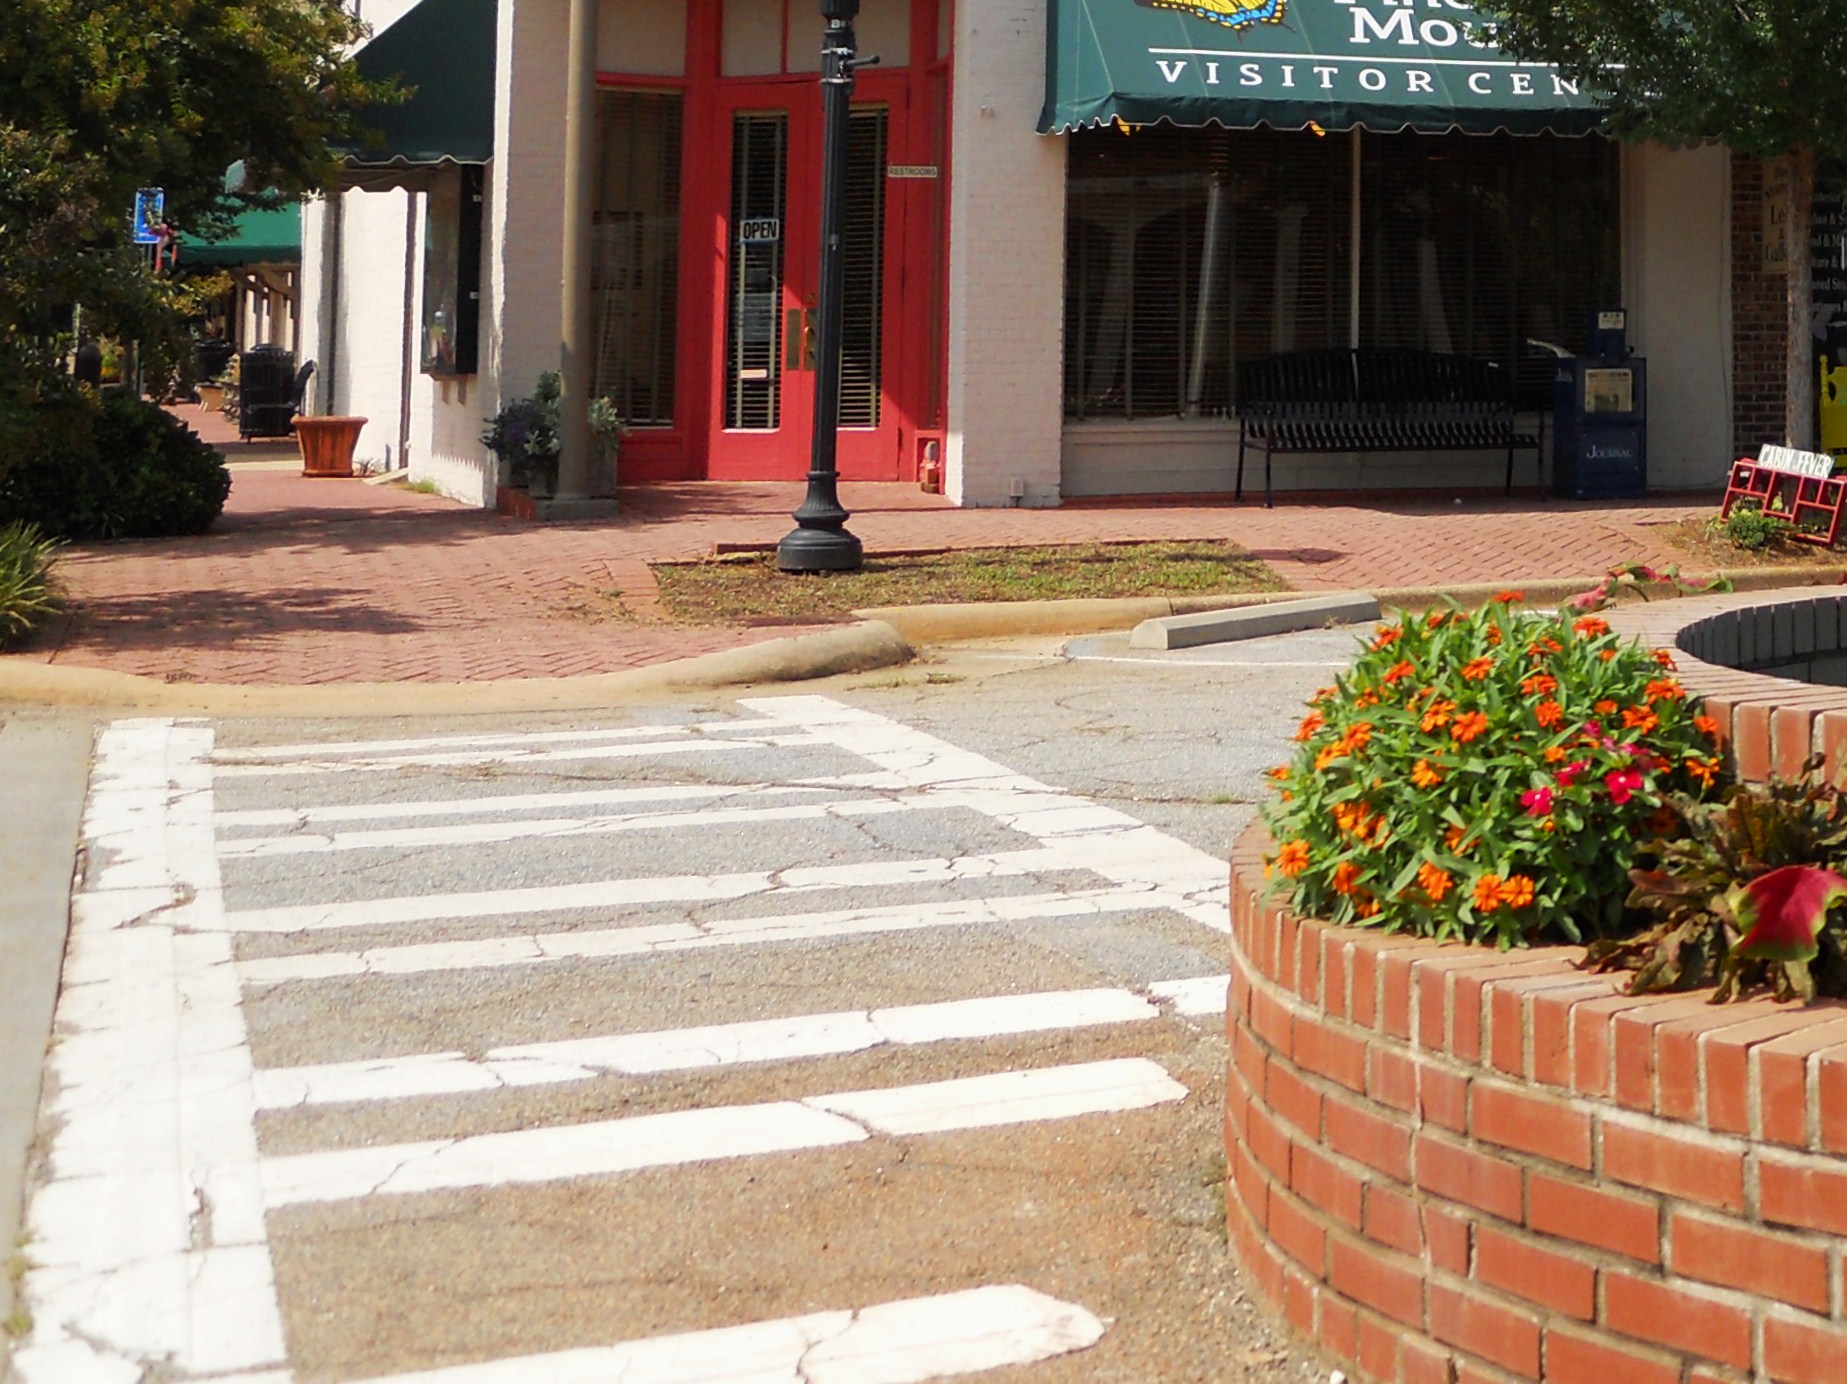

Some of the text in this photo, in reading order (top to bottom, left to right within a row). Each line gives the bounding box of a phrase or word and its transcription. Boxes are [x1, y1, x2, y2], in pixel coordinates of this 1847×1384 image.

[1156, 60, 1582, 95] VISITOR CEN
[743, 221, 778, 239] OPEN
[1586, 445, 1632, 460] JOURNAL
[1760, 445, 1832, 478] CABIN FEVER
